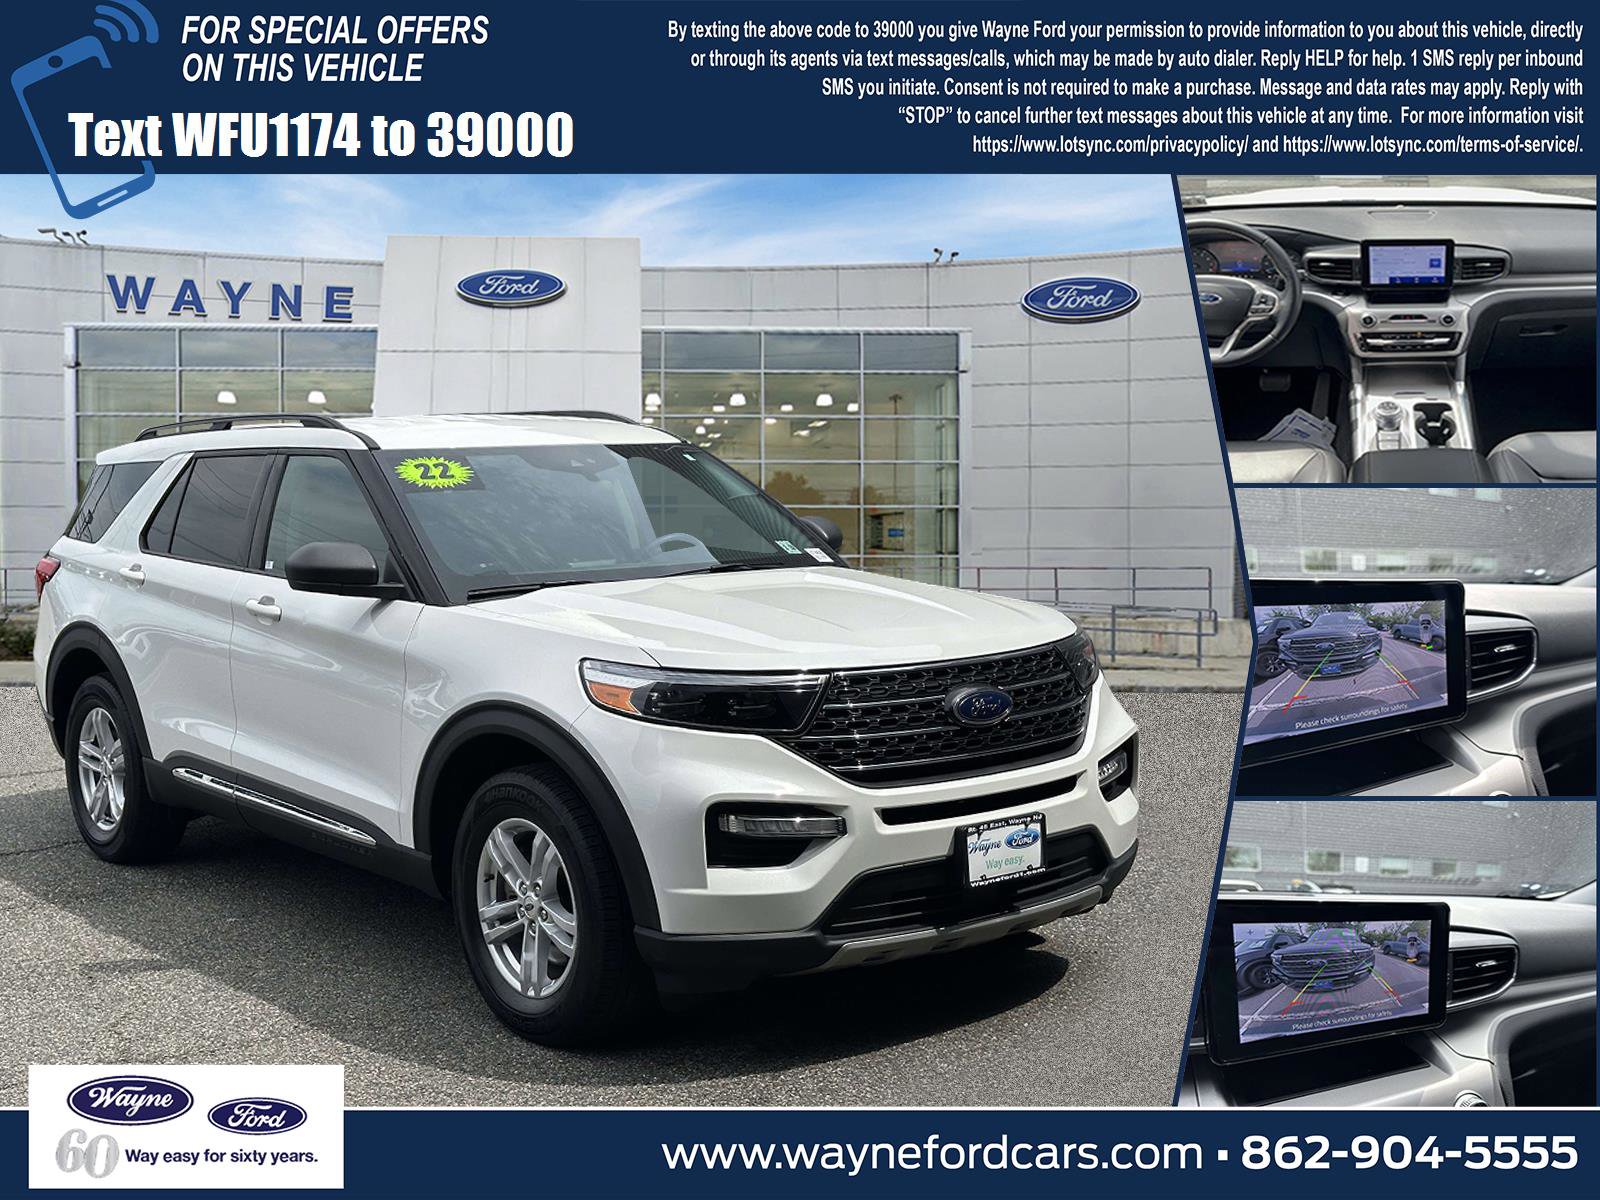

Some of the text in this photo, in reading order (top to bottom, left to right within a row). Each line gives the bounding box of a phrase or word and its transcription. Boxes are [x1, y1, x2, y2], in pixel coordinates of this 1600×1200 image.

[106, 274, 354, 321] WAYNE
[413, 462, 455, 480] 22
[1295, 719, 1320, 730] Please
[1319, 715, 1341, 726] check
[1340, 708, 1380, 721] surroundings
[968, 838, 1002, 856] Wayne
[985, 858, 1003, 870] Way
